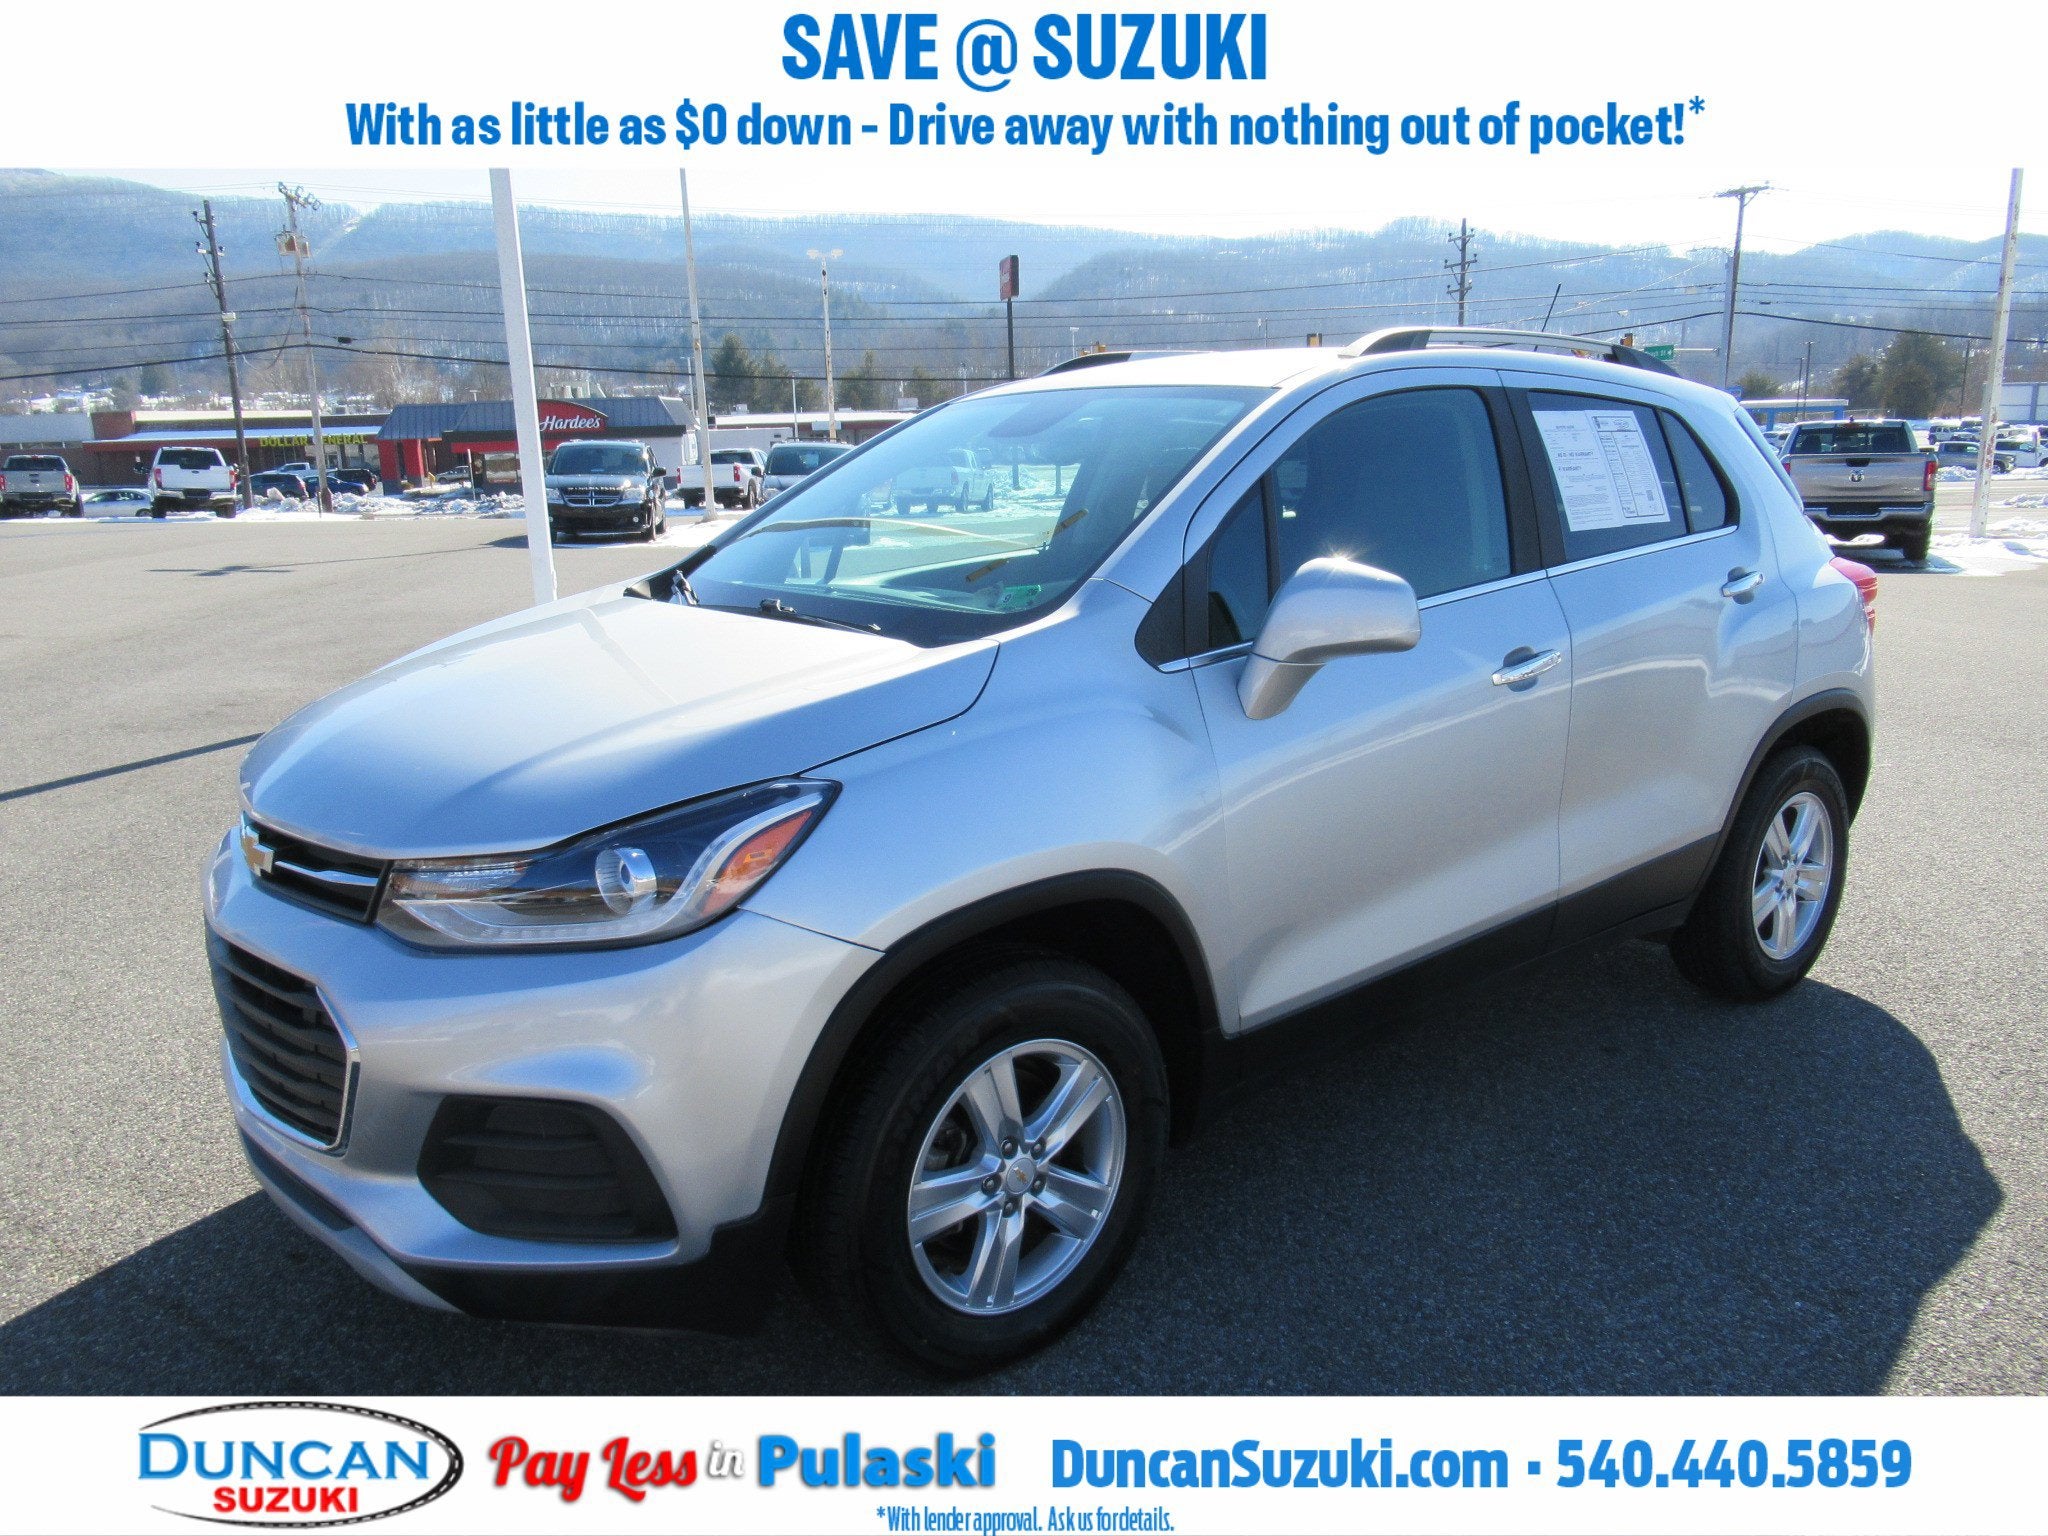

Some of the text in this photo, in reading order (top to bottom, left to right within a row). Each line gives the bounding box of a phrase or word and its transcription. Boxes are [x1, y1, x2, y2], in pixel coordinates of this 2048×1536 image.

[539, 414, 601, 432] Hardee's
[259, 433, 368, 447] DOLLAR ENERAL
